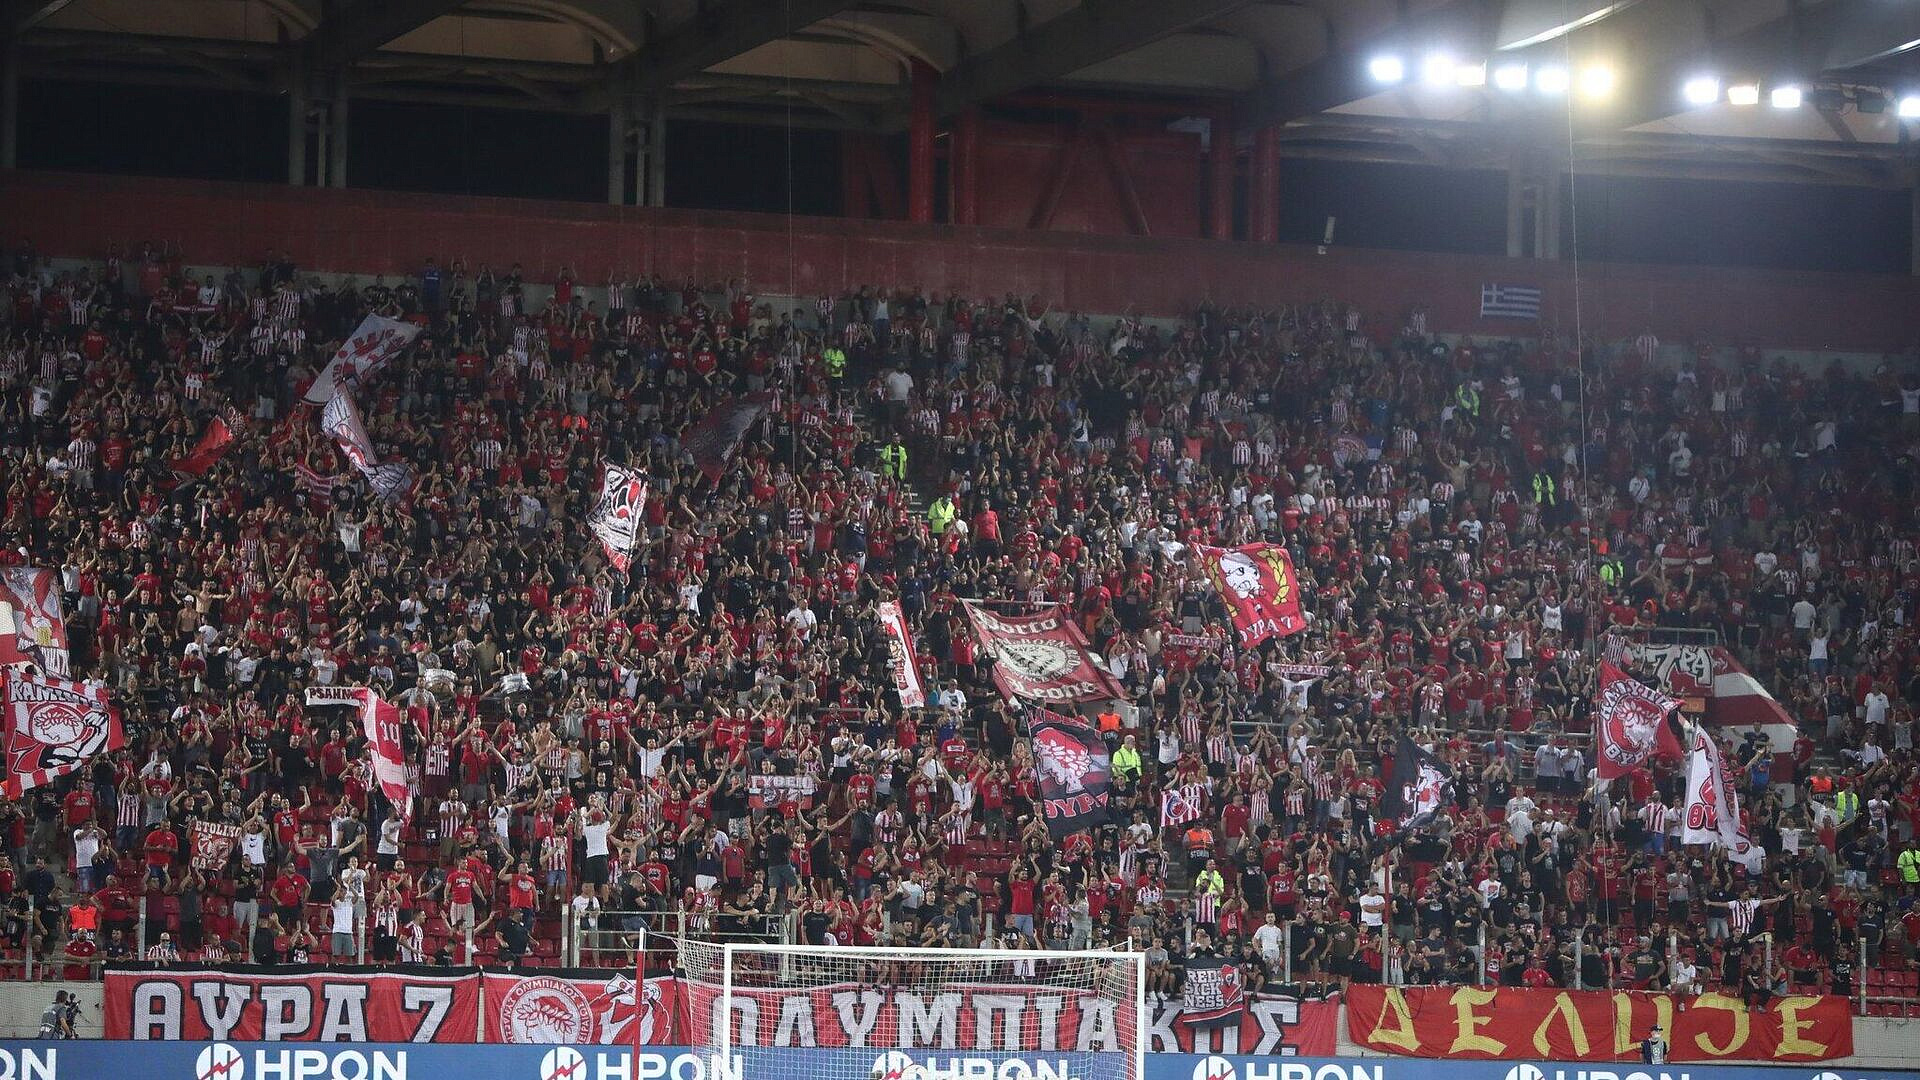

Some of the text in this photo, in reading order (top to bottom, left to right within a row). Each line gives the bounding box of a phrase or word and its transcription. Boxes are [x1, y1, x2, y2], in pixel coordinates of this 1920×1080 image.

[1184, 982, 1222, 997] SICK
[1184, 994, 1224, 1009] NESS
[404, 987, 452, 1043] 7
